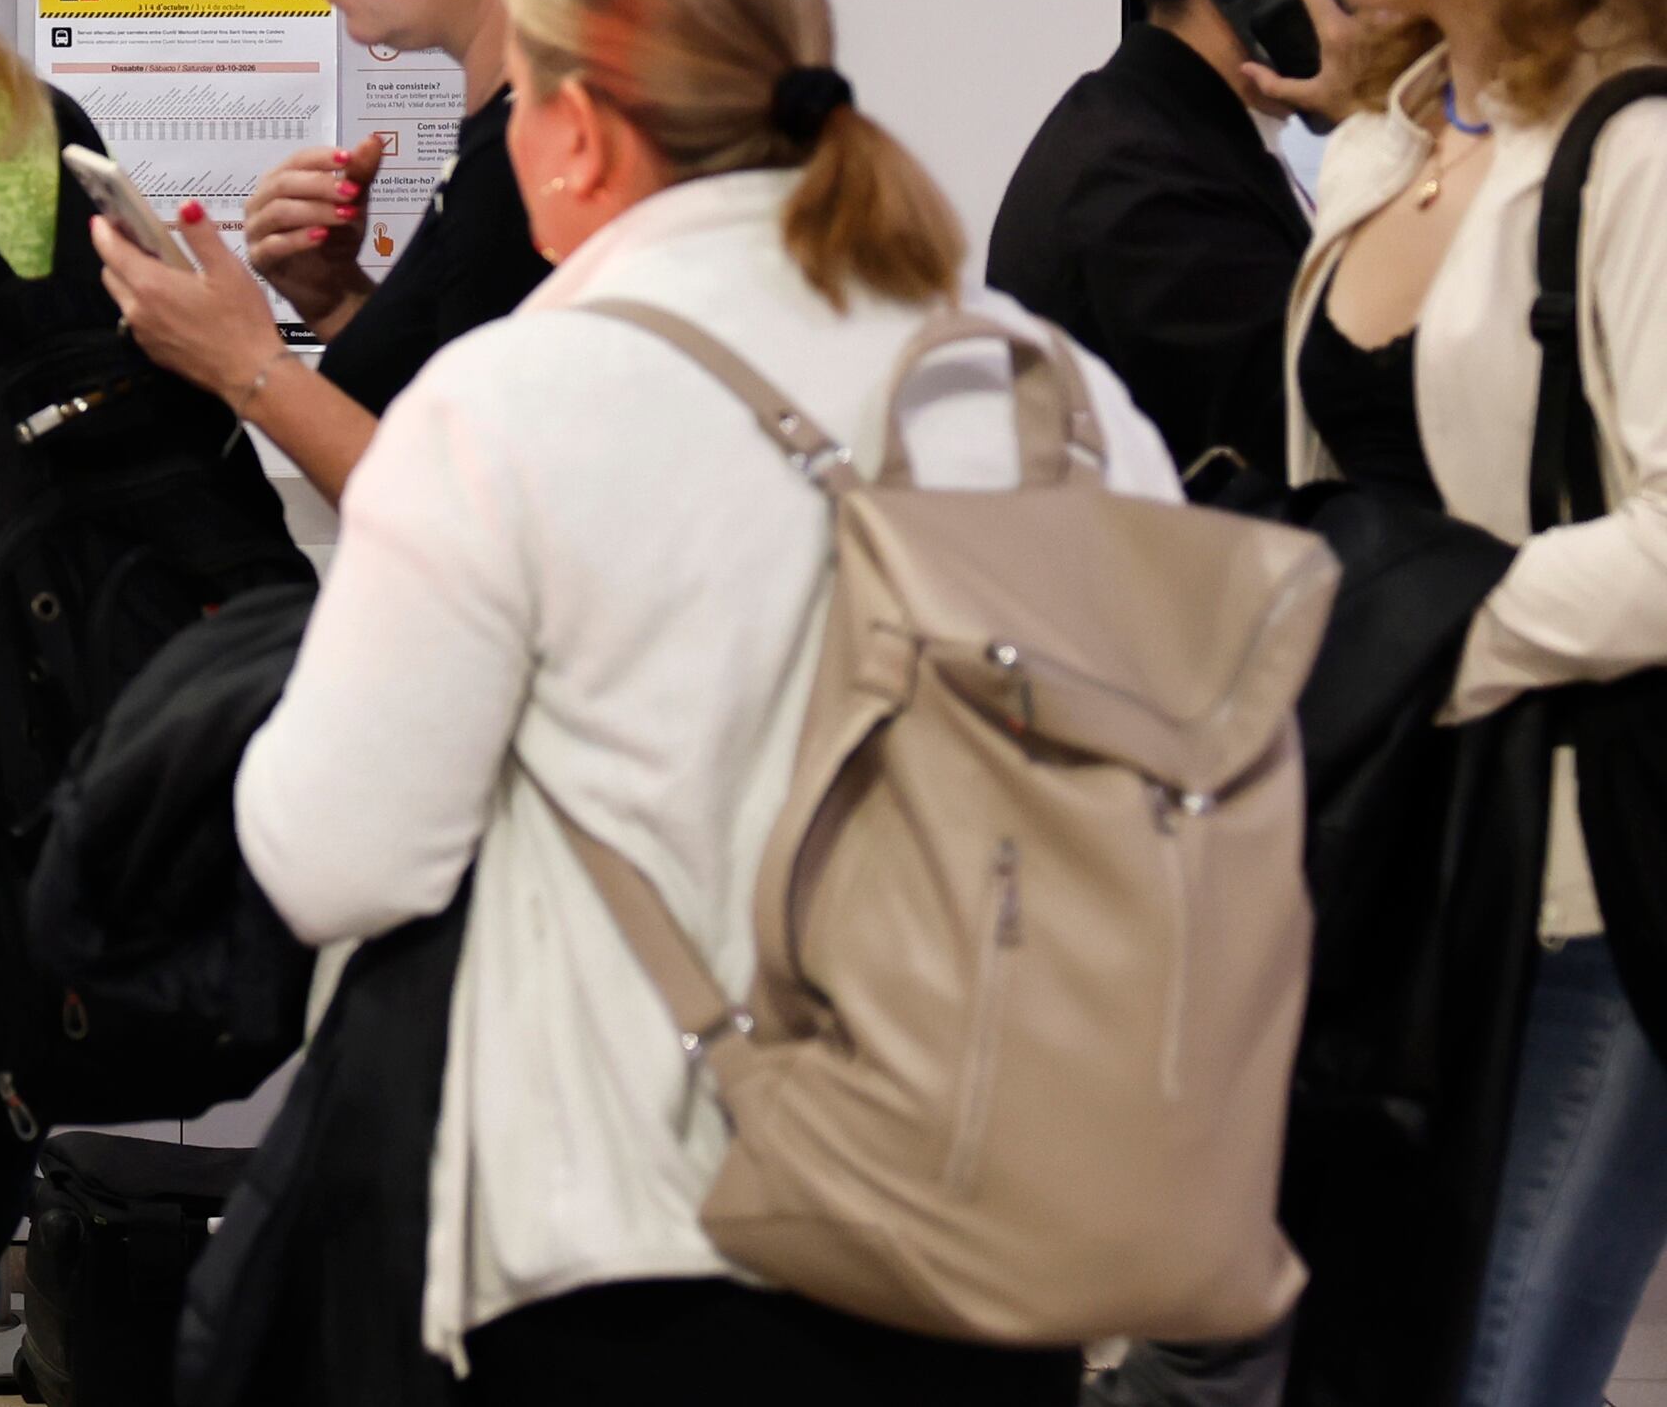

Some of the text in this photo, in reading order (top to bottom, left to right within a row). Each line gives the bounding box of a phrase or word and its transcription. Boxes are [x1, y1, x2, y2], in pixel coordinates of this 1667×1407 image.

[111, 64, 144, 72] Dissabte
[215, 64, 256, 72] 03-10-2026
[366, 82, 441, 92] En què consisteix?
